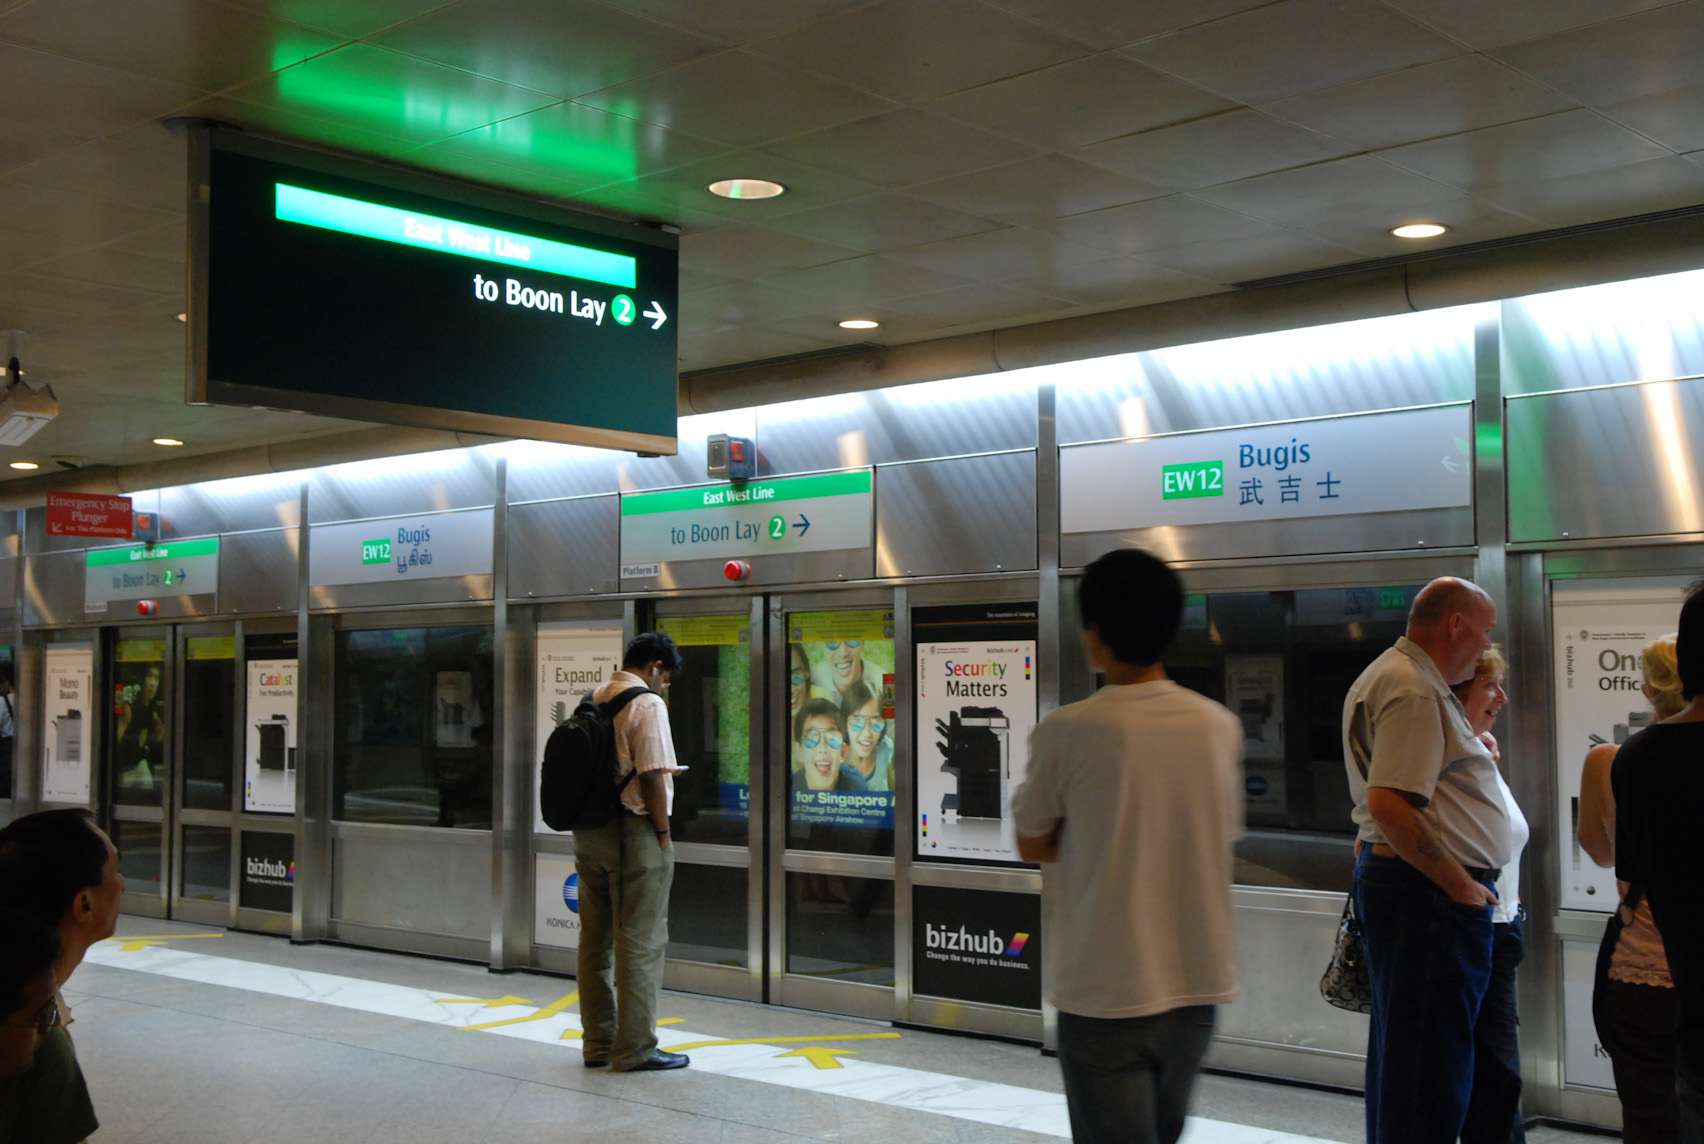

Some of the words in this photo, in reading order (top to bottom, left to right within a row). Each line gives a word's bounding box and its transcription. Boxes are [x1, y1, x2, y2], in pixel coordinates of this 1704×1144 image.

[404, 217, 444, 243] East
[447, 228, 491, 253] West
[494, 236, 531, 261] Line
[474, 274, 498, 302] to
[506, 279, 563, 313] Boon
[571, 291, 606, 327] Lay
[617, 298, 632, 323] 2
[1239, 438, 1310, 470] Bugis
[1164, 468, 1222, 493] EW12
[1239, 472, 1341, 506] 武吉士
[703, 491, 724, 504] East
[727, 489, 750, 502] West
[753, 486, 774, 500] Line
[50, 496, 106, 511] Emergency
[108, 500, 130, 513] Stop
[72, 511, 108, 525] Plunger
[398, 524, 431, 546] Bugis
[672, 527, 685, 544] to
[691, 524, 729, 543] Boon
[736, 520, 760, 542] Lay
[772, 518, 782, 537] 2
[363, 544, 391, 561] EW12
[164, 572, 172, 585] 2
[623, 566, 652, 576] Platform
[556, 667, 602, 686] Expand
[945, 660, 1007, 679] Security
[946, 680, 1008, 697] Matters
[1598, 676, 1642, 691] Offic
[796, 791, 814, 803] for
[817, 792, 888, 807] Singapore
[247, 857, 286, 878] bizhub
[546, 918, 577, 928] KONICA
[926, 923, 1004, 955] bizhub
[926, 951, 949, 962] Change
[962, 956, 975, 964] way
[976, 958, 988, 966] you
